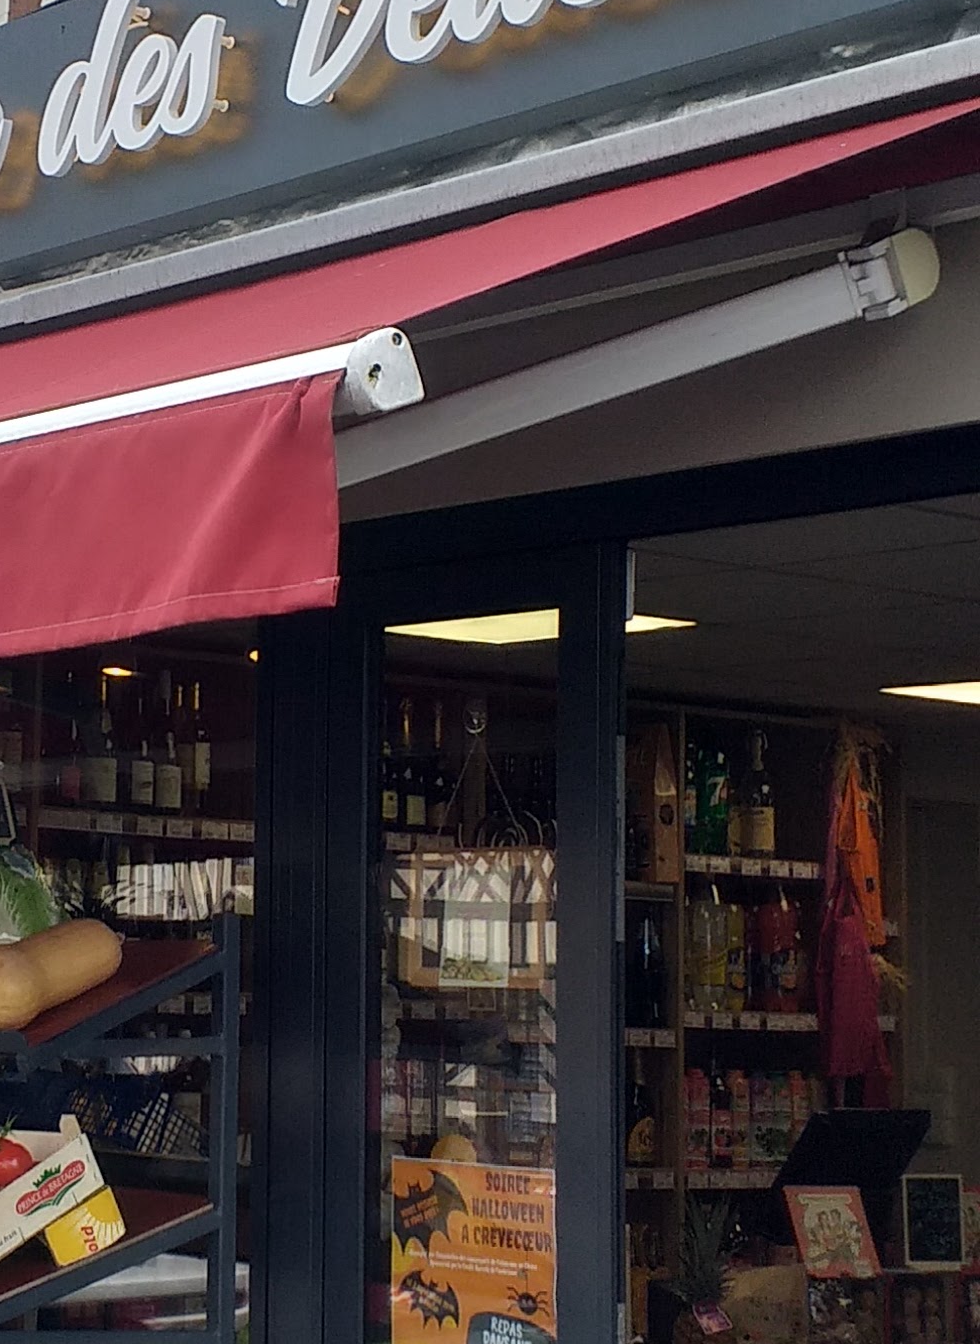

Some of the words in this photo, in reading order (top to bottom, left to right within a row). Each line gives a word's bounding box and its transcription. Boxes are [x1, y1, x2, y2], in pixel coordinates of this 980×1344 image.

[18, 1192, 44, 1213] PRINCE
[42, 1186, 50, 1198] de
[48, 1162, 84, 1194] BRETAGNE
[472, 1197, 545, 1224] HALLOWEEN
[473, 1222, 552, 1253] CRÈVECŒUR
[490, 1315, 523, 1338] REPAS
